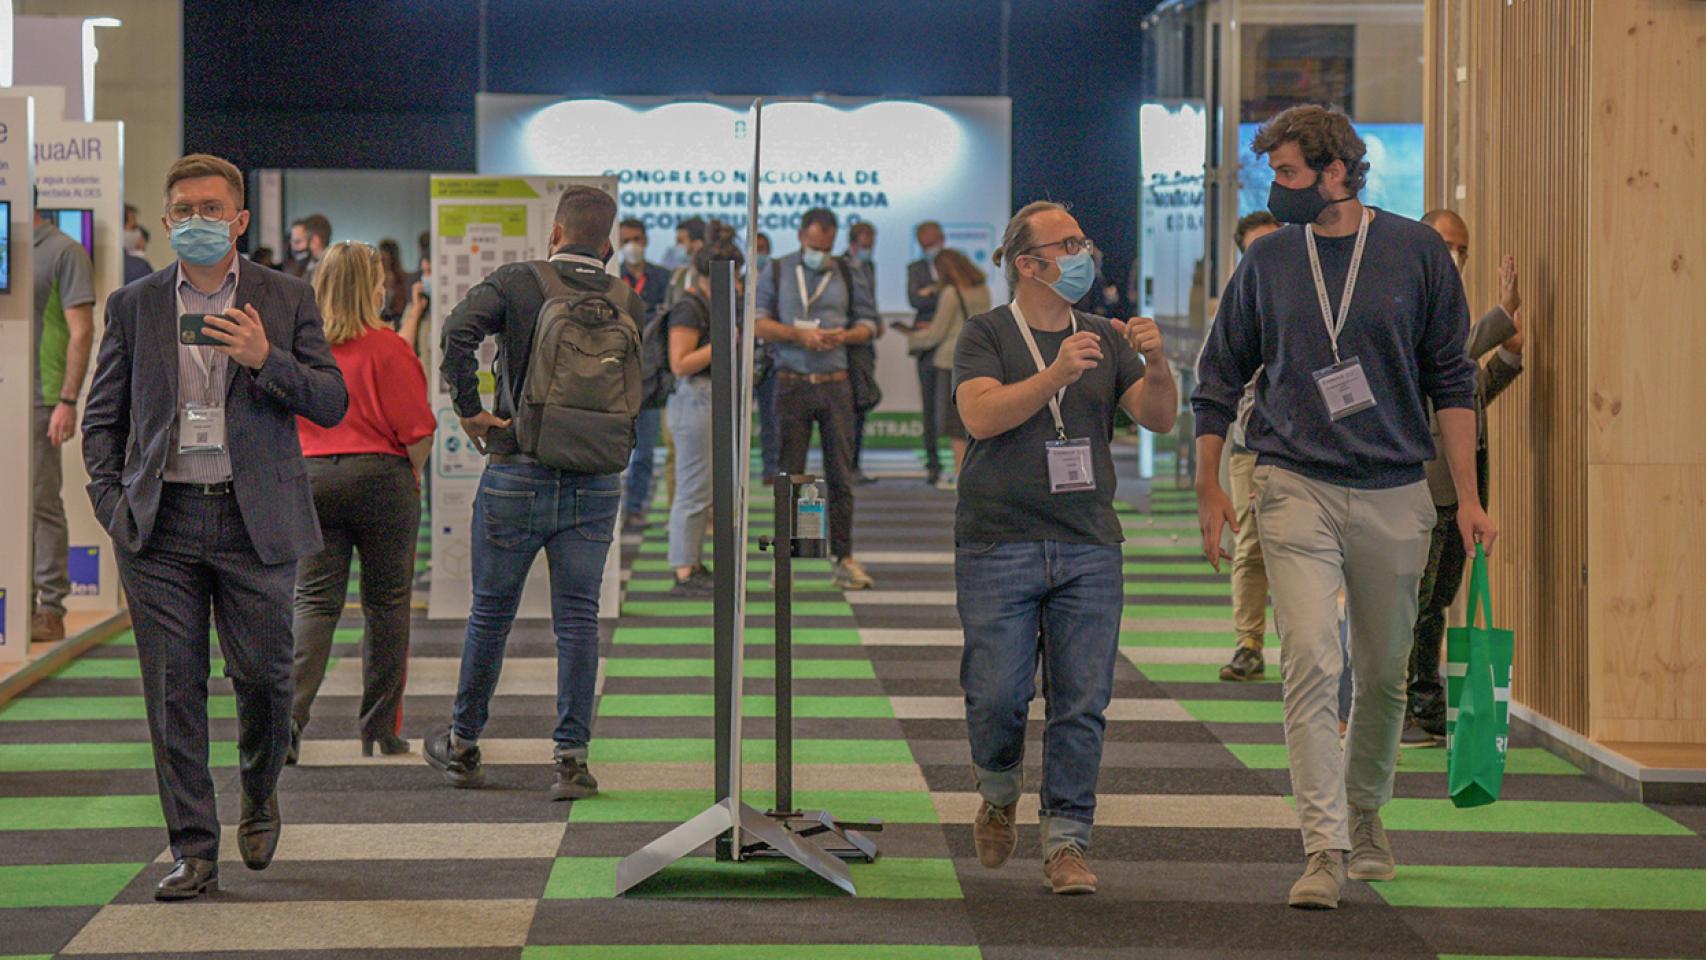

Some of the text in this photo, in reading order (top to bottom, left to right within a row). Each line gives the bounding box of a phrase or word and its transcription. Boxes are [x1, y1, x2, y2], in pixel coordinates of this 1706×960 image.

[733, 170, 847, 185] NCIONAL
[855, 170, 880, 185] DE
[620, 191, 889, 208] QUITECTUR AVANZADA
